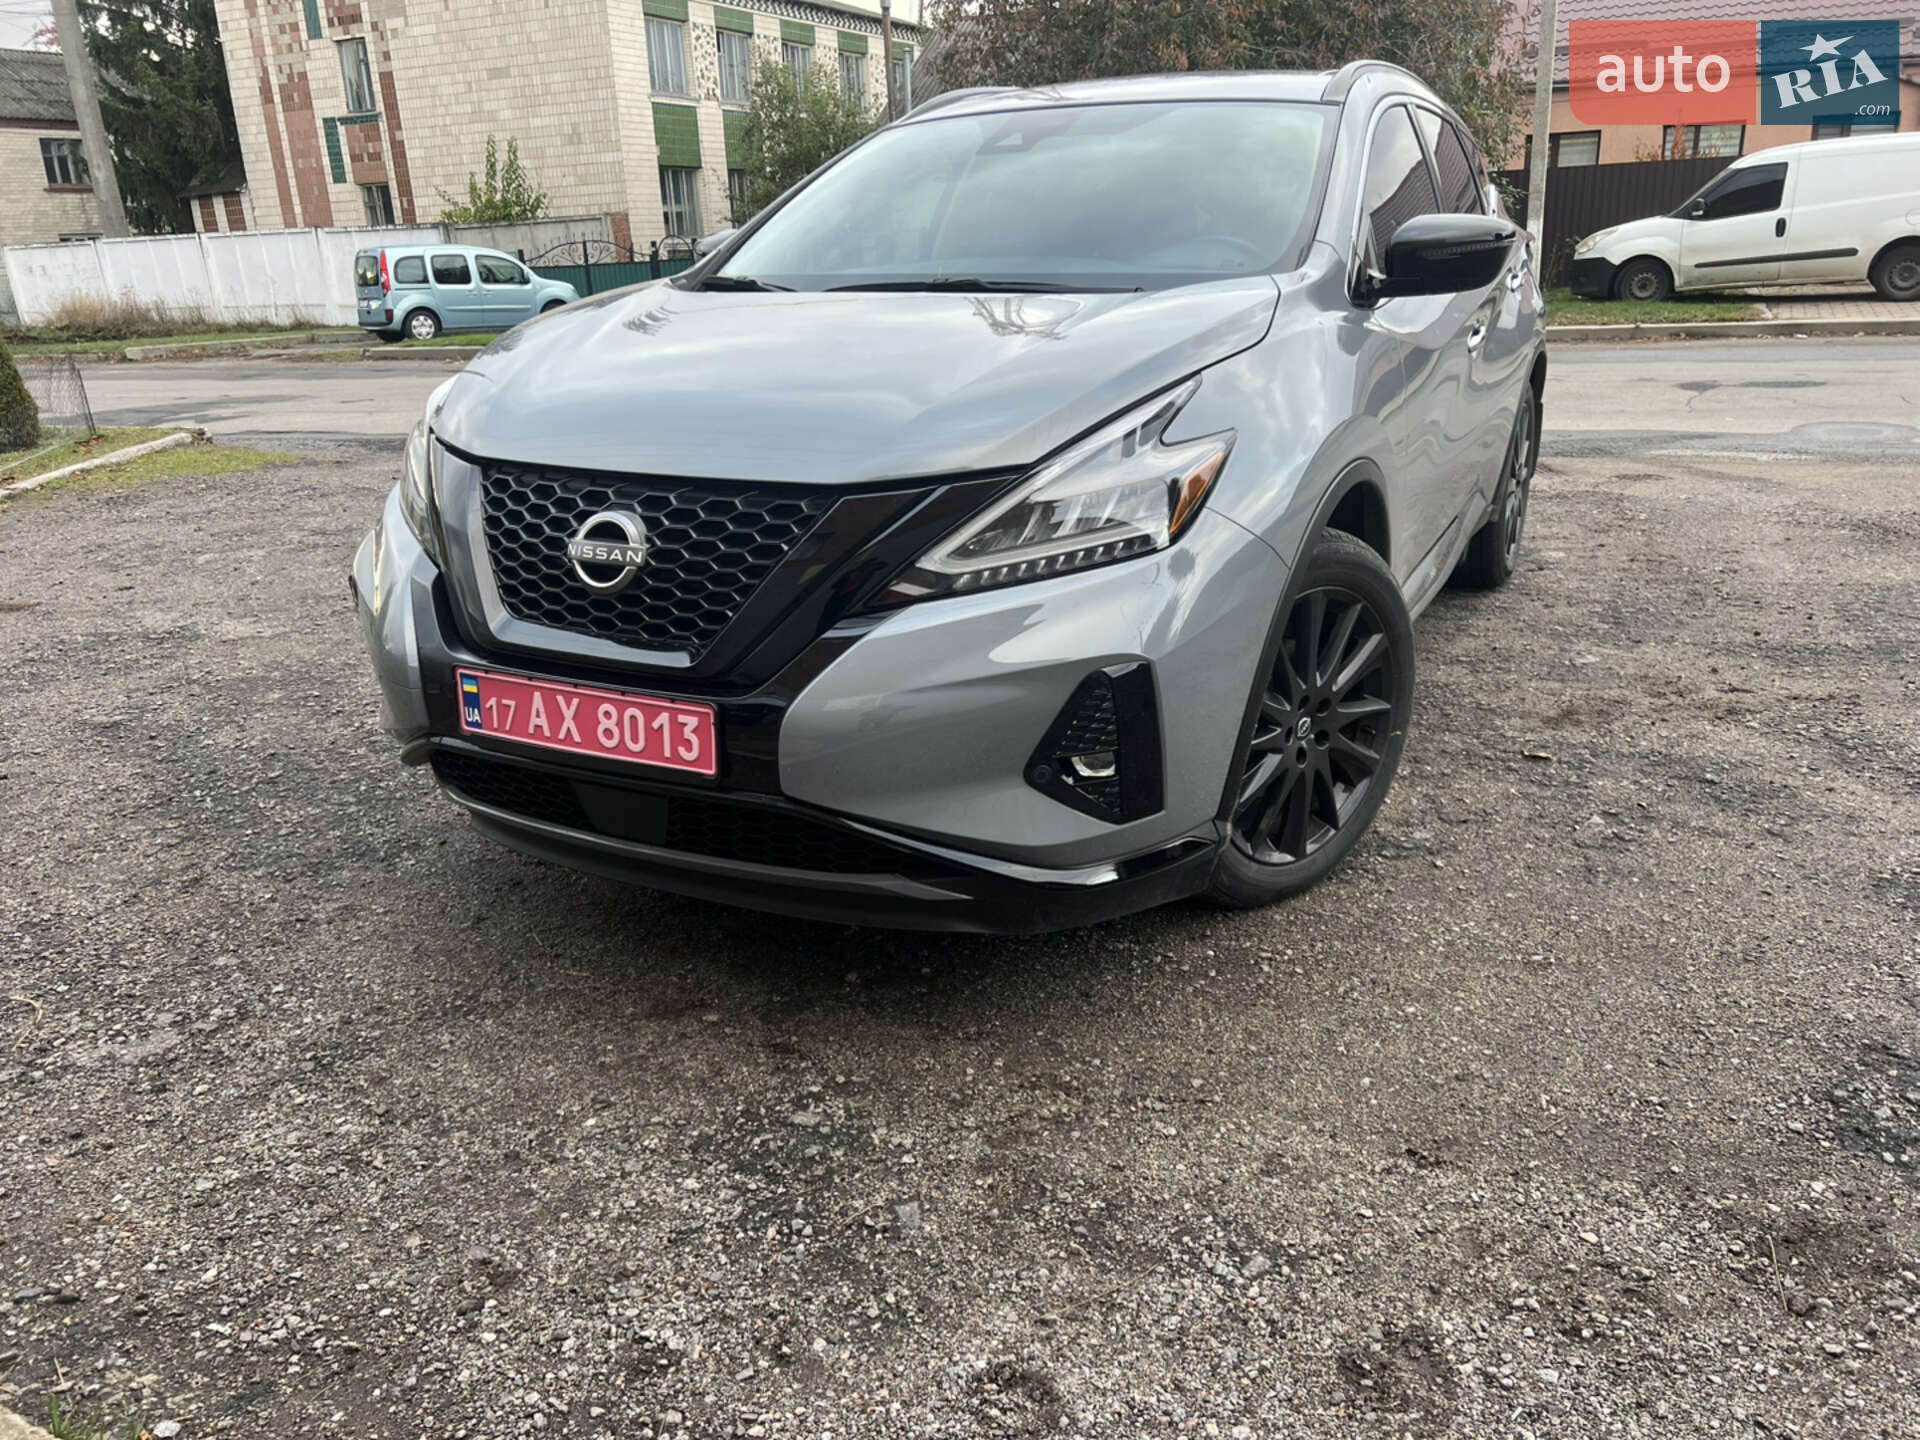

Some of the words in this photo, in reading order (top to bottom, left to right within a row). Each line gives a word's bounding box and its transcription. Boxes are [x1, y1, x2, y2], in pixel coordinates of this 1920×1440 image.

[567, 543, 643, 563] NISSAN
[465, 706, 481, 723] UA
[485, 697, 516, 731] 17
[527, 691, 582, 743] AX
[597, 703, 700, 761] 8013
